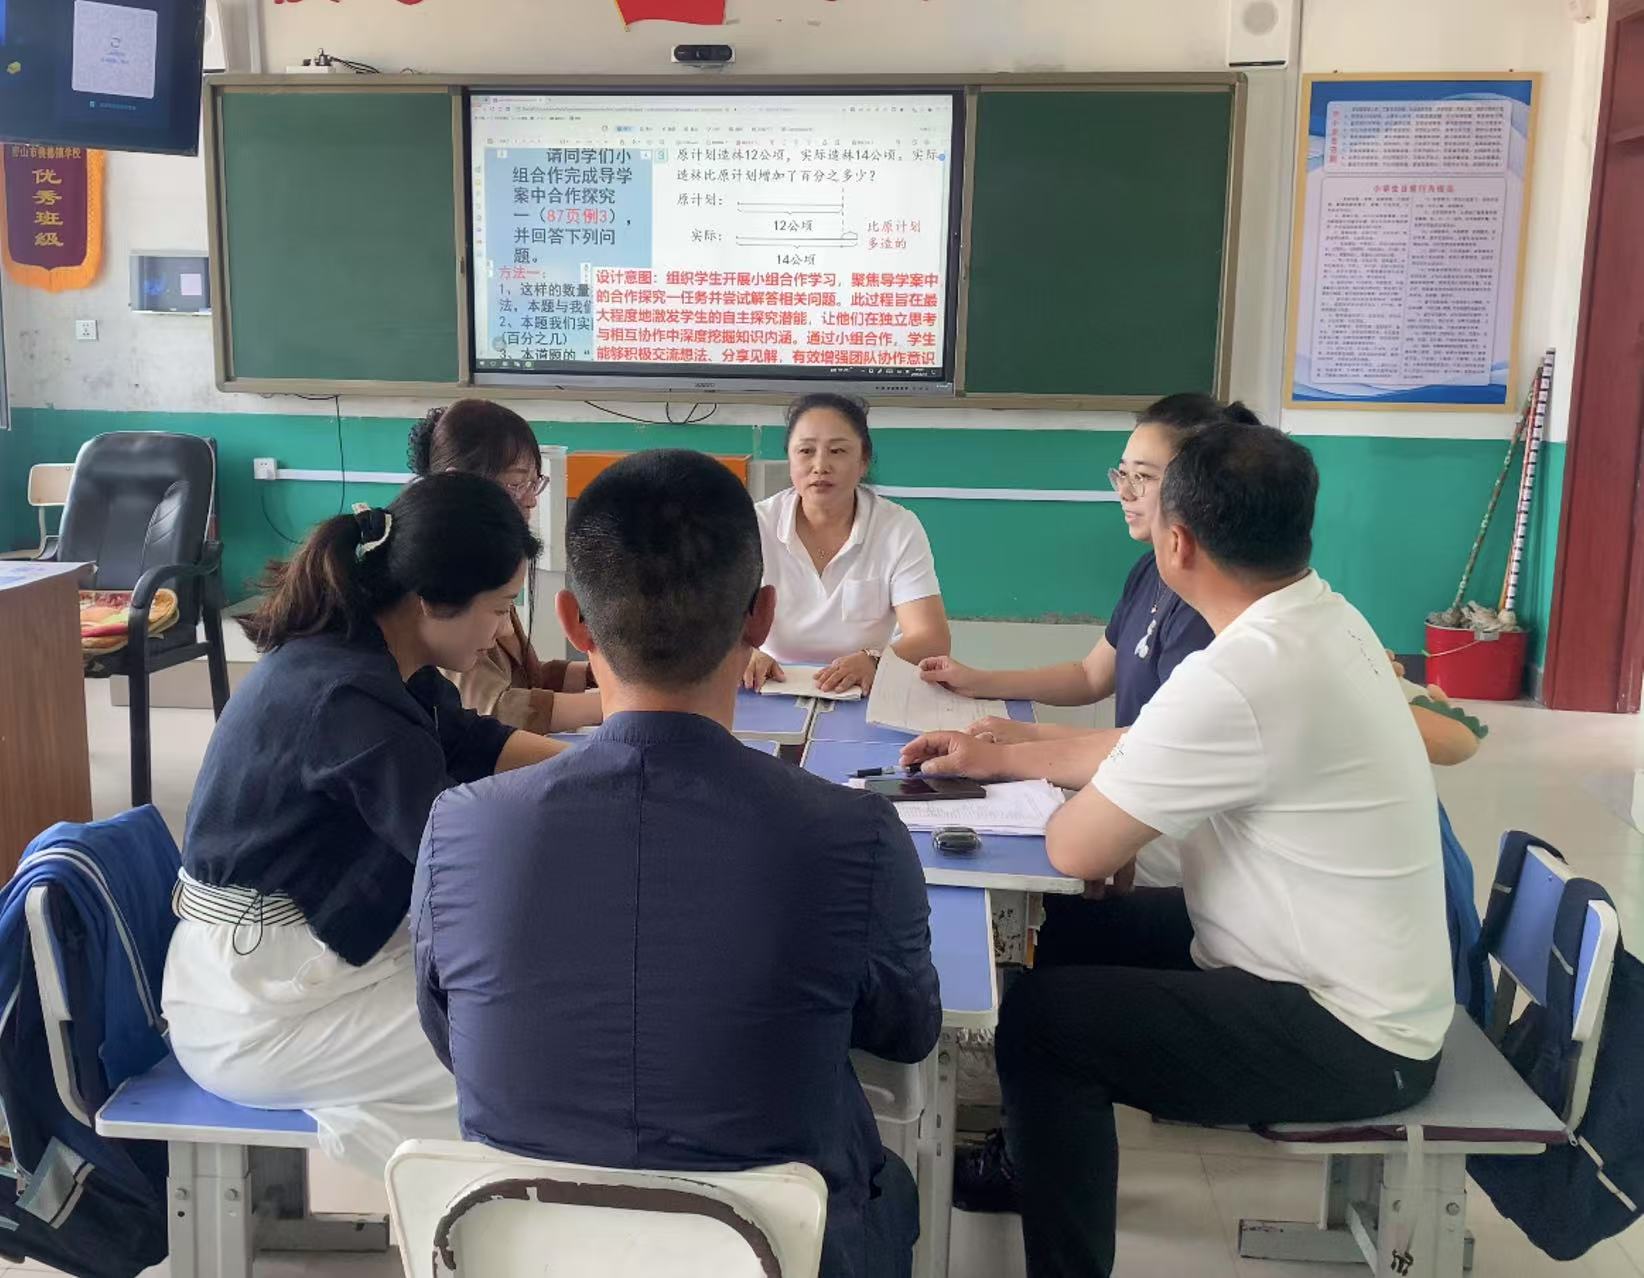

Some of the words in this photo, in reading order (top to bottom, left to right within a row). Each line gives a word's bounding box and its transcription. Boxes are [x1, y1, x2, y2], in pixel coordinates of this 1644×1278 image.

[547, 147, 631, 164] 请同学们小
[513, 166, 633, 184] 组合作完成导学
[677, 170, 876, 182] 造林比原计划增加了百分之多少？
[513, 187, 616, 204] 案中合作探究
[677, 193, 723, 206] 原计划：
[32, 168, 64, 247] 优秀班级
[774, 220, 813, 232] 12公顷
[867, 220, 921, 233] 比原计划
[514, 227, 616, 245] 并回答下列问
[691, 230, 722, 242] 实际：
[867, 238, 907, 250] 多造的
[513, 248, 538, 264] 题。
[776, 254, 816, 266] 14公顷
[499, 267, 546, 280] 方法一：
[596, 270, 938, 287] 设计意图：组织学生开展小组合作学习，聚焦导学案中
[499, 283, 590, 298] 1、这样的数量
[596, 290, 938, 307] 的合作探究一任务并尝试解答相关问题。此过程旨在最
[499, 315, 594, 330] 2、本题我们实
[596, 308, 937, 327] 大程度地激发学生的自主探究潜能，让他们在独立思考
[502, 331, 568, 346] （百分之几）
[597, 328, 936, 347] 与相互协作中深度挖掘知识内涵。通过小组合作，学生
[596, 347, 935, 366] 能够积极交流想法、分享见解，有效增强团队协作意识
